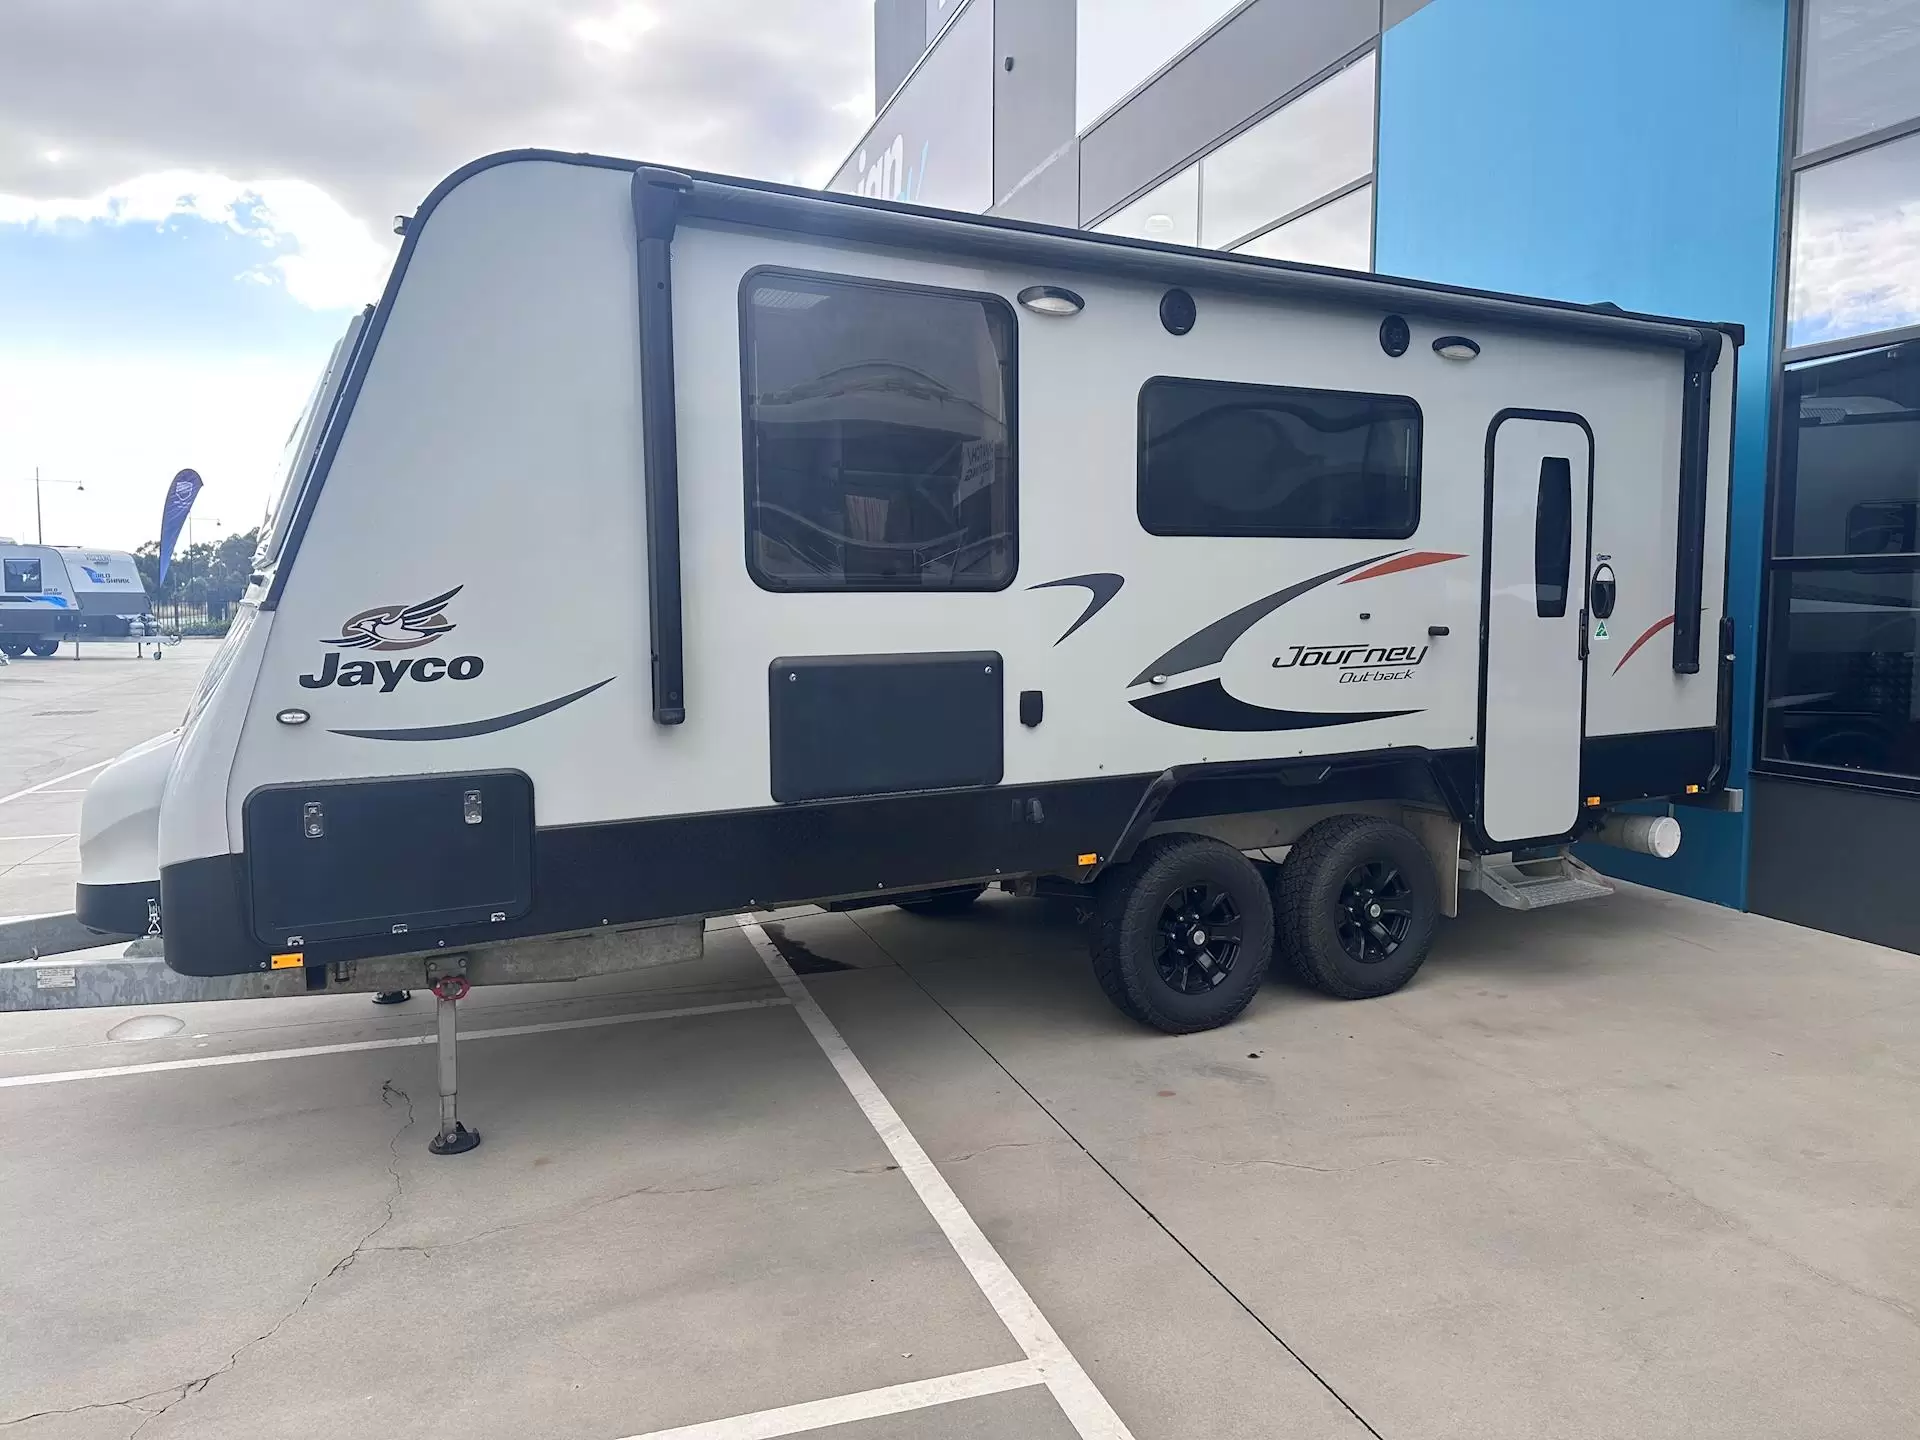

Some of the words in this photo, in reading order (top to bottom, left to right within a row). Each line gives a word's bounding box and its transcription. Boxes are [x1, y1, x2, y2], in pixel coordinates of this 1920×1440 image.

[1272, 643, 1429, 670] Journey
[299, 652, 485, 693] Jayco
[1339, 669, 1416, 684] Outback
